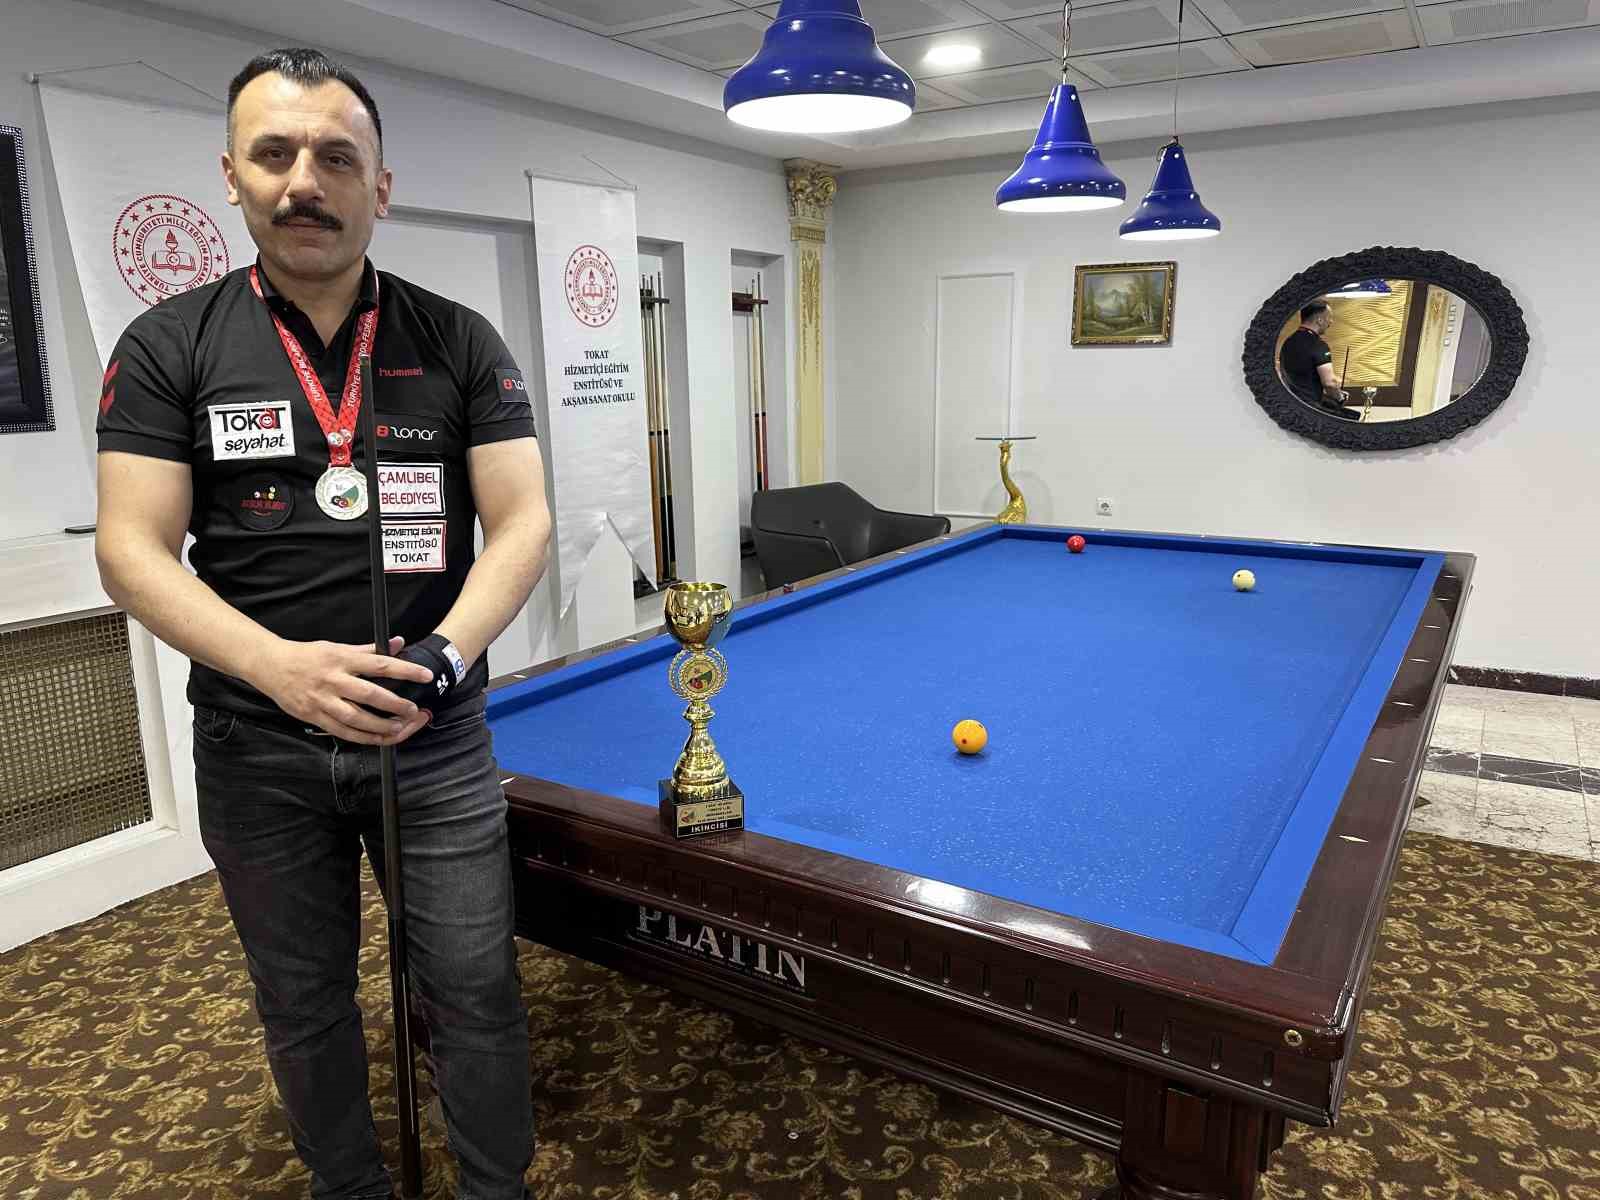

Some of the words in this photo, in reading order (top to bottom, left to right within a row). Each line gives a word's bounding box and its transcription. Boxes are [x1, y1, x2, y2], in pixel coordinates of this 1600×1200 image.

[584, 349, 609, 359] TOKAT
[564, 362, 604, 376] HİZMETİÇİ
[604, 361, 629, 374] EĞİTİM
[573, 377, 613, 391] ENSTİTÜSÜ
[613, 378, 624, 388] VE
[561, 396, 588, 408] AKŞAM
[588, 394, 612, 405] SANAT
[224, 433, 286, 455] seyahat
[392, 552, 431, 564] TOKAT
